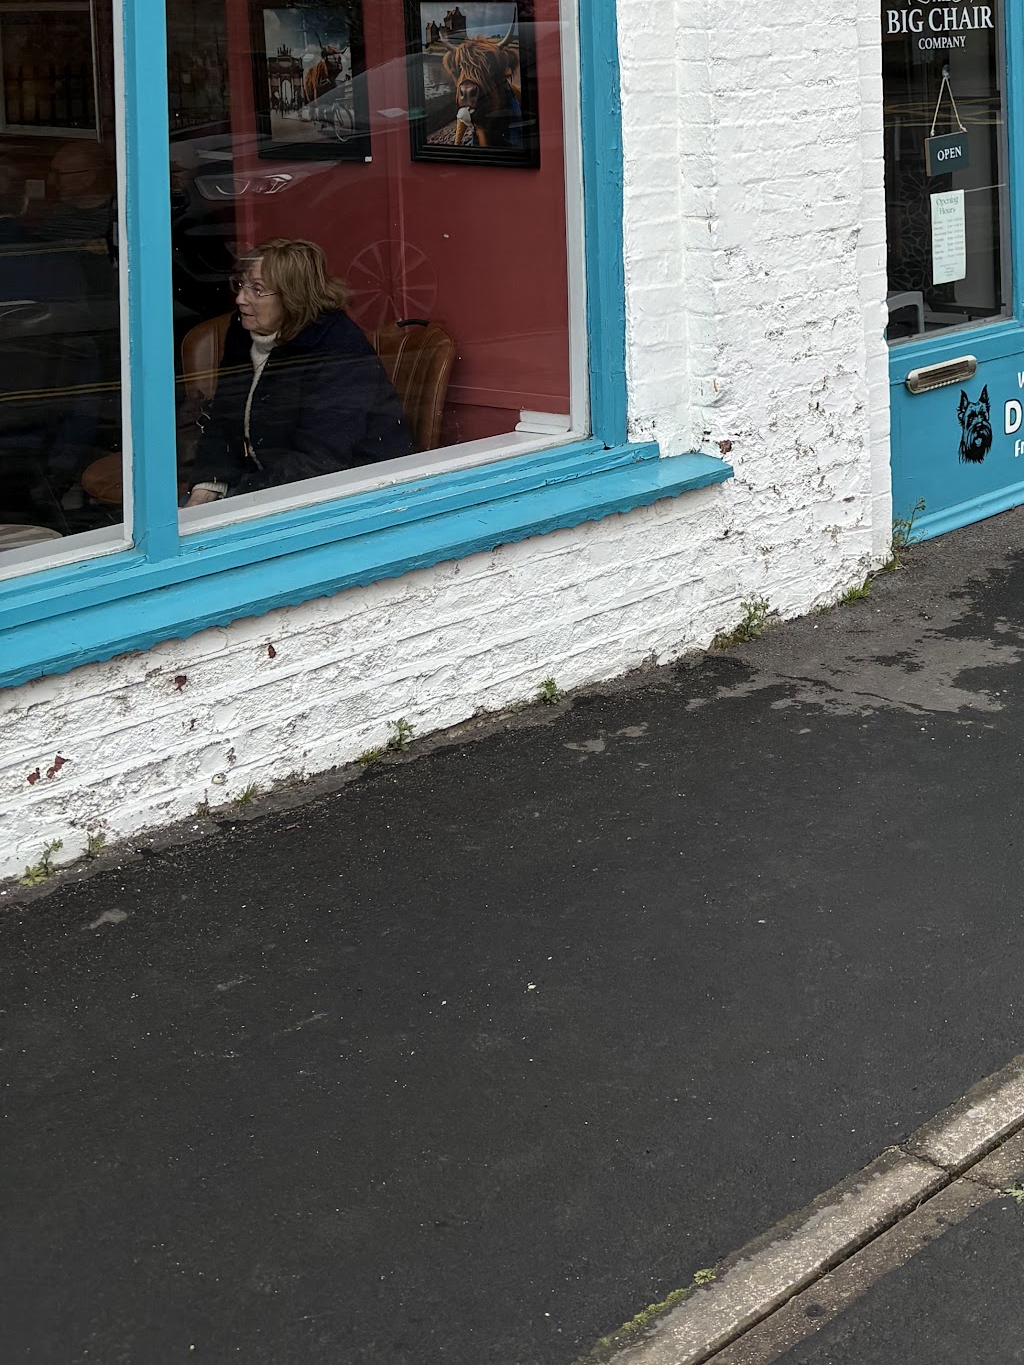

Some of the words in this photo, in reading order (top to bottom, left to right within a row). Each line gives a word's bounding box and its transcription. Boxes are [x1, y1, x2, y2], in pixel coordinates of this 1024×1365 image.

[886, 8, 924, 34] BIG
[928, 5, 994, 32] CHAIR
[918, 35, 966, 50] COMPANY
[937, 146, 962, 162] OPEN
[939, 207, 956, 215] Hours
